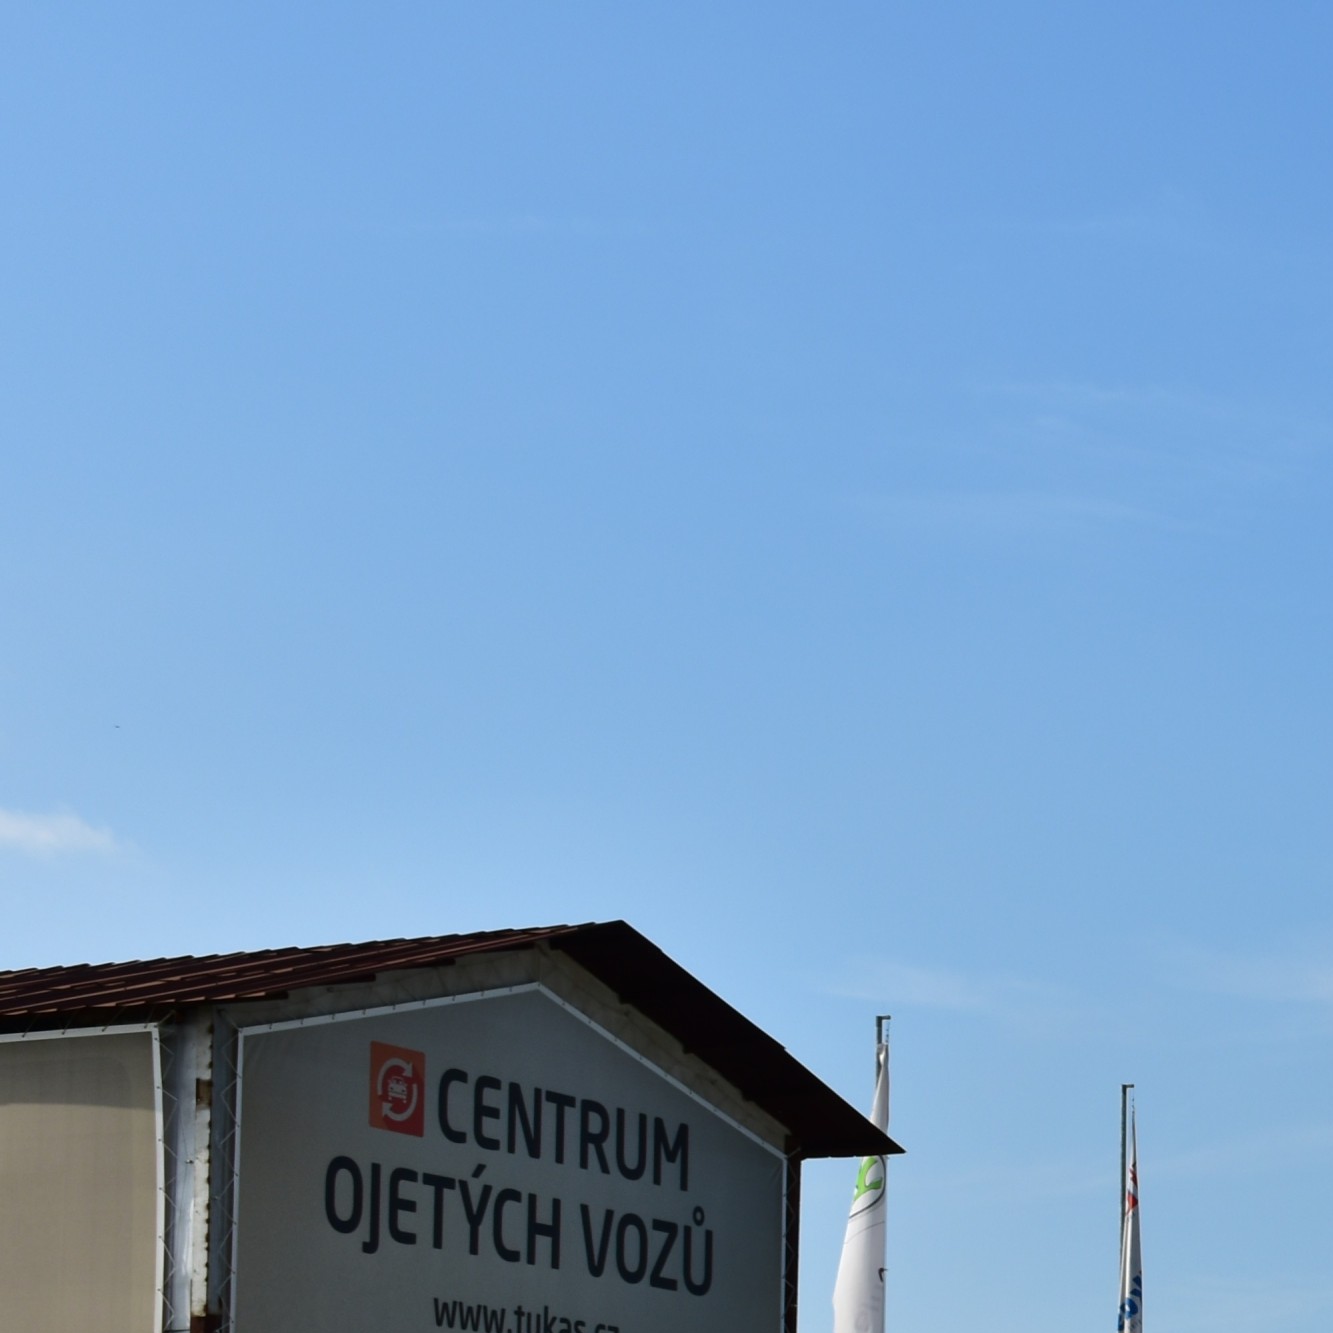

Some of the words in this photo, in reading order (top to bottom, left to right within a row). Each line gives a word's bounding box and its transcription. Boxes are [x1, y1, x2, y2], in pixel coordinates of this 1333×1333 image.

[438, 1068, 689, 1191] CENTRUM
[325, 1155, 561, 1270] OJETÝCH
[580, 1206, 713, 1296] VOZŮ
